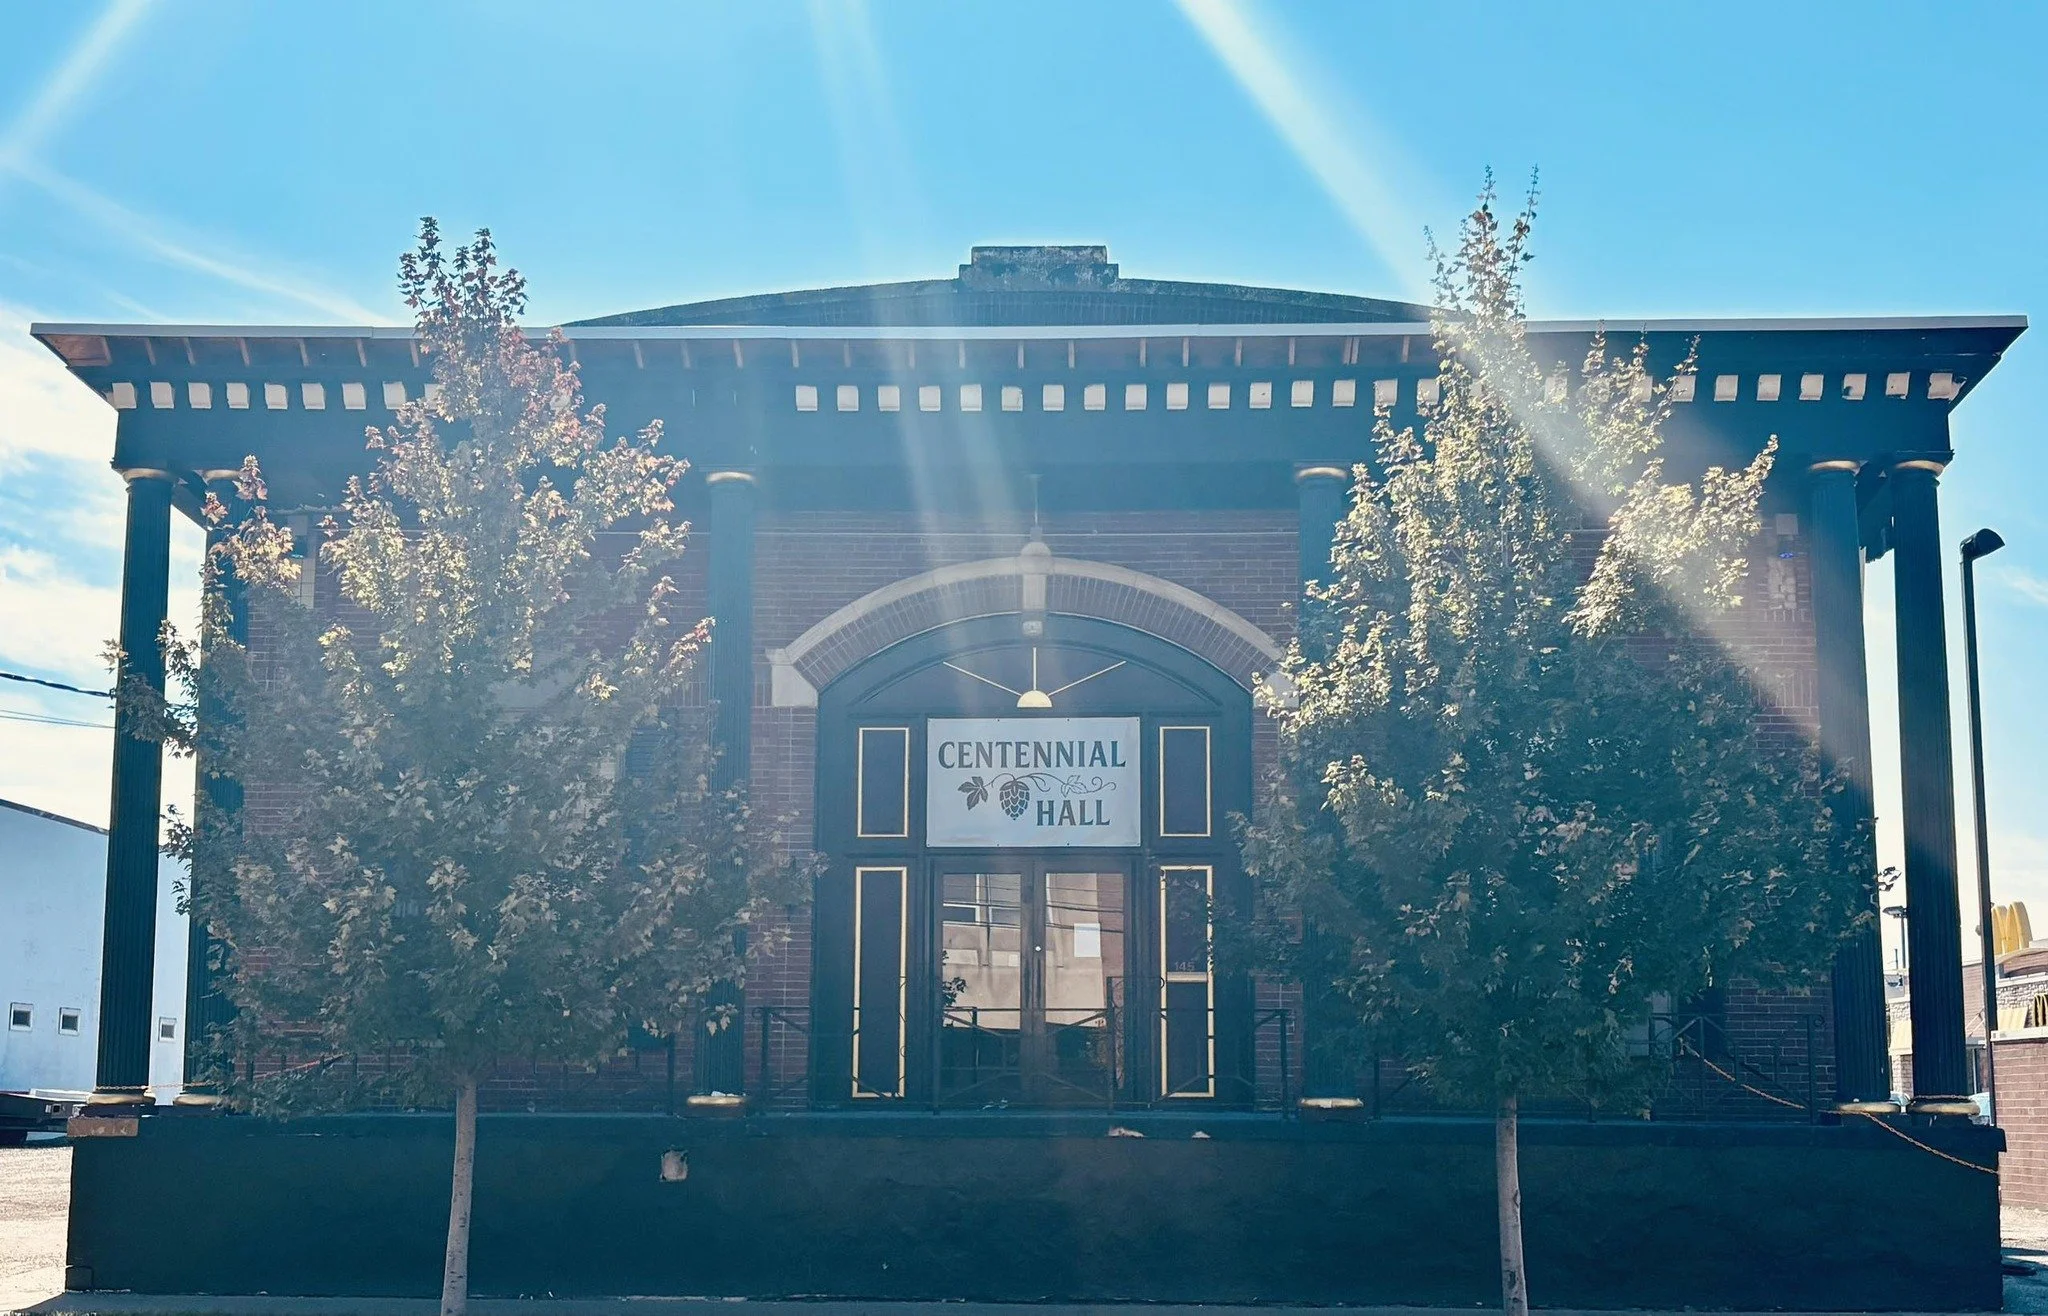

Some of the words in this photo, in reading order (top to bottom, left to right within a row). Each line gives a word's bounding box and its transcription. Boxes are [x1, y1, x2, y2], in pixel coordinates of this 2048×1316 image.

[938, 740, 1126, 769] CENTENNIAL
[1036, 799, 1111, 826] HALL
[1174, 961, 1196, 971] 145
